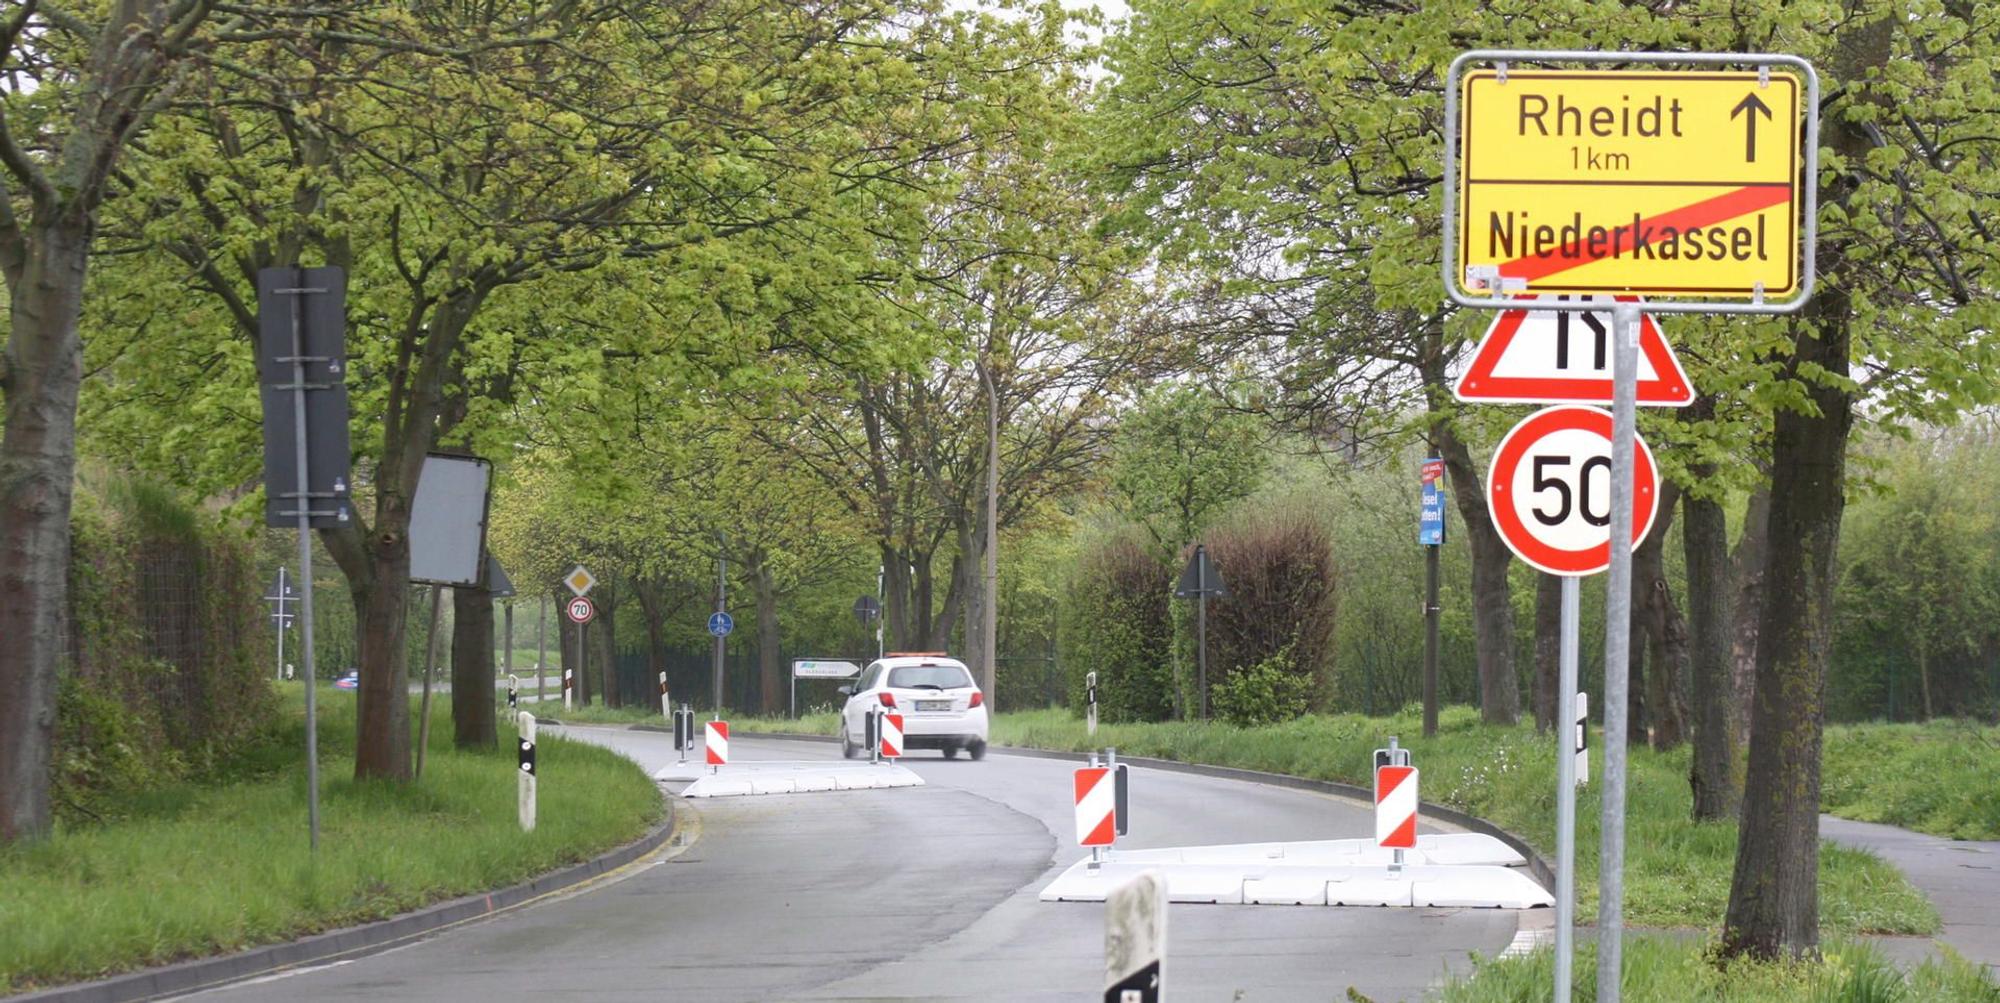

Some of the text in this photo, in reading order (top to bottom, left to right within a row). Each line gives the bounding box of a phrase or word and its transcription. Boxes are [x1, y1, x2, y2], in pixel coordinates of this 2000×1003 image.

[1518, 94, 1683, 137] Rheidt
[1488, 211, 1768, 261] Niederkassel
[1532, 455, 1612, 527] 50
[573, 604, 588, 616] 70
